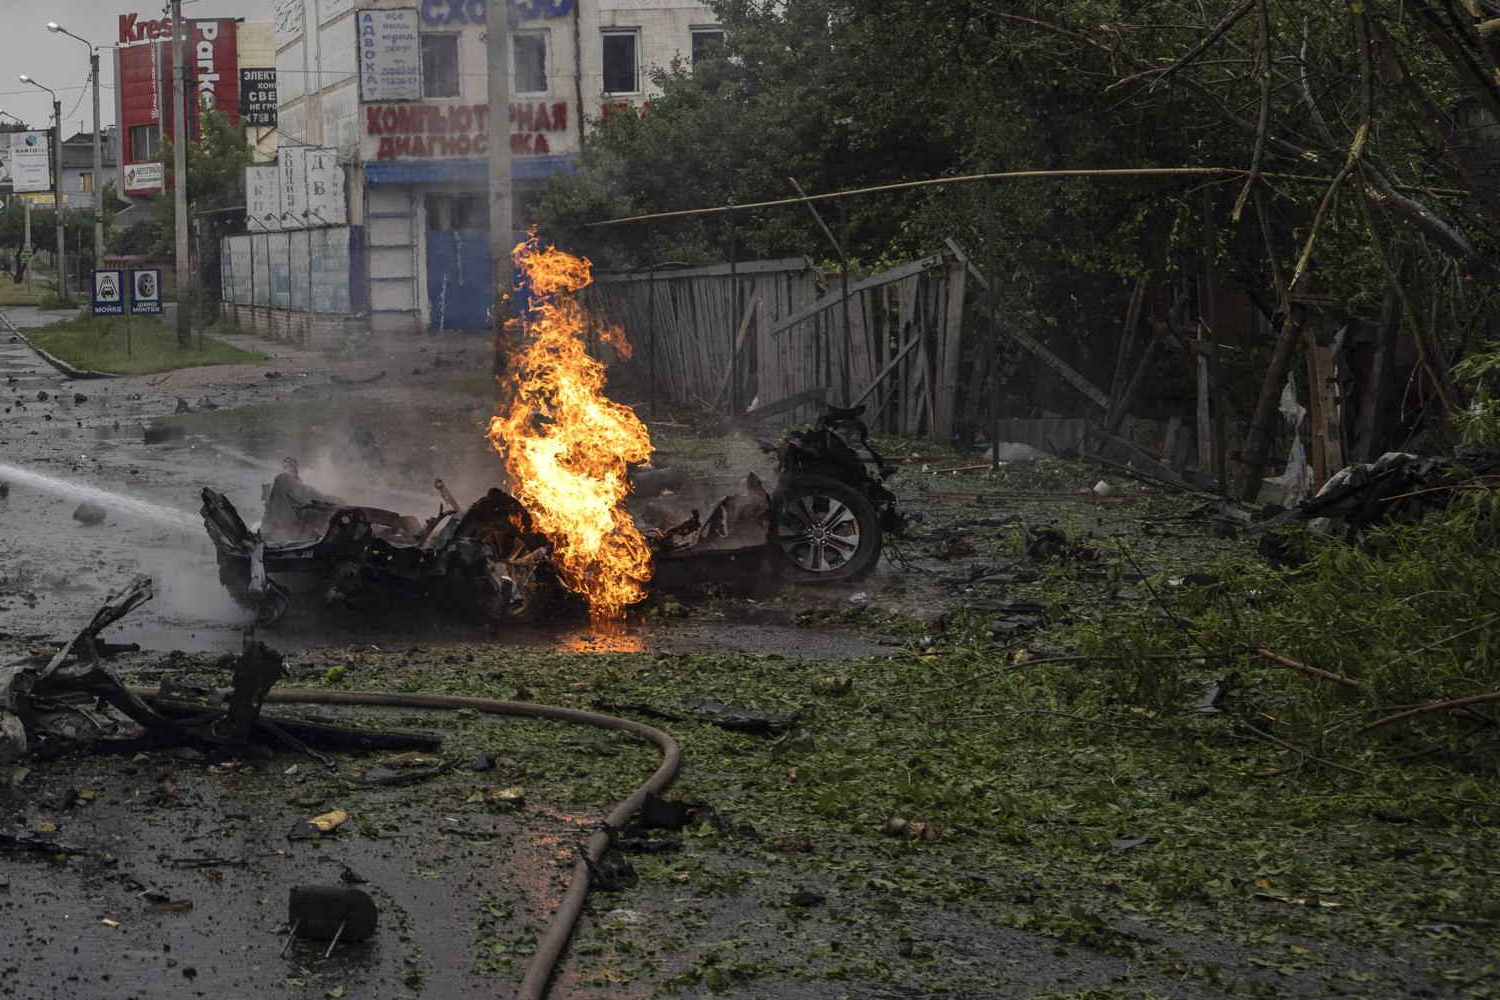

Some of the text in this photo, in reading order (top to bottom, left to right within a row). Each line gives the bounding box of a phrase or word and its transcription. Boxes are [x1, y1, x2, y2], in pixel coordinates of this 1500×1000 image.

[119, 12, 186, 43] Kres
[195, 21, 220, 112] Parke
[249, 91, 276, 102] СВЕ
[367, 102, 567, 135] КОМПЬЮТРНАЯ
[378, 133, 549, 160] ДИАГНОСИКА
